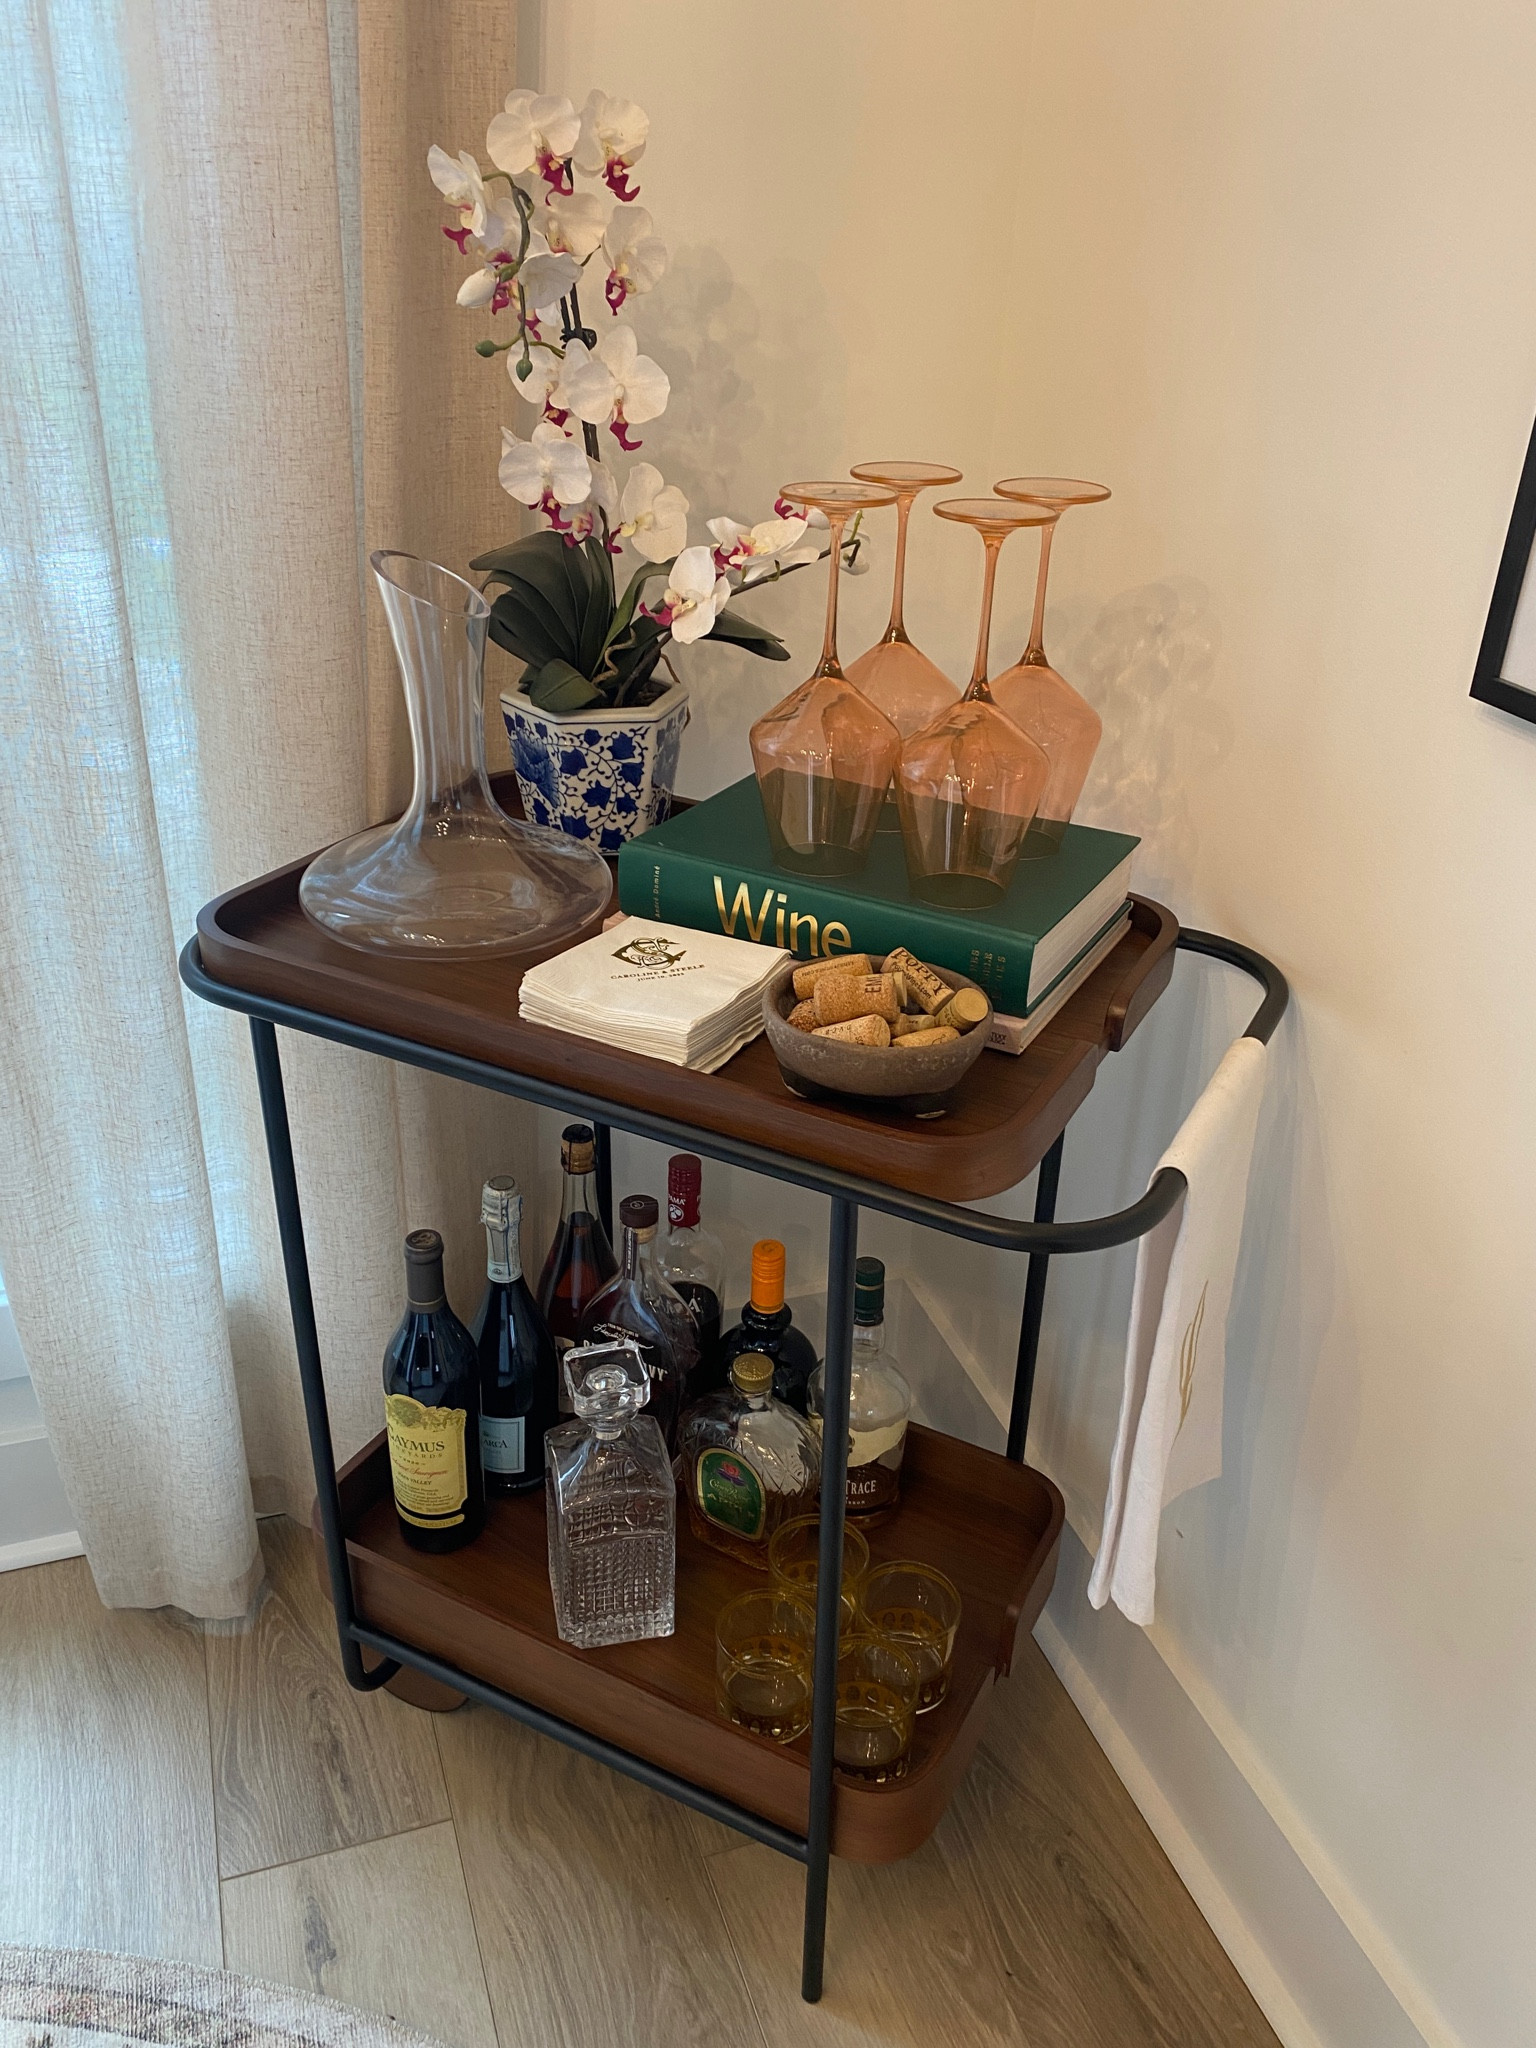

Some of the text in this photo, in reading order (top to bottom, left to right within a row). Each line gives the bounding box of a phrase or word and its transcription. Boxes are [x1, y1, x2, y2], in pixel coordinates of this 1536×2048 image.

[653, 865, 661, 894] Dominé
[713, 875, 852, 958] Wine
[611, 970, 660, 980] CAROLINE
[670, 964, 705, 973] STEELE
[890, 949, 948, 995] POPPY
[483, 1439, 508, 1449] ARCA
[845, 1479, 877, 1495] TRACE
